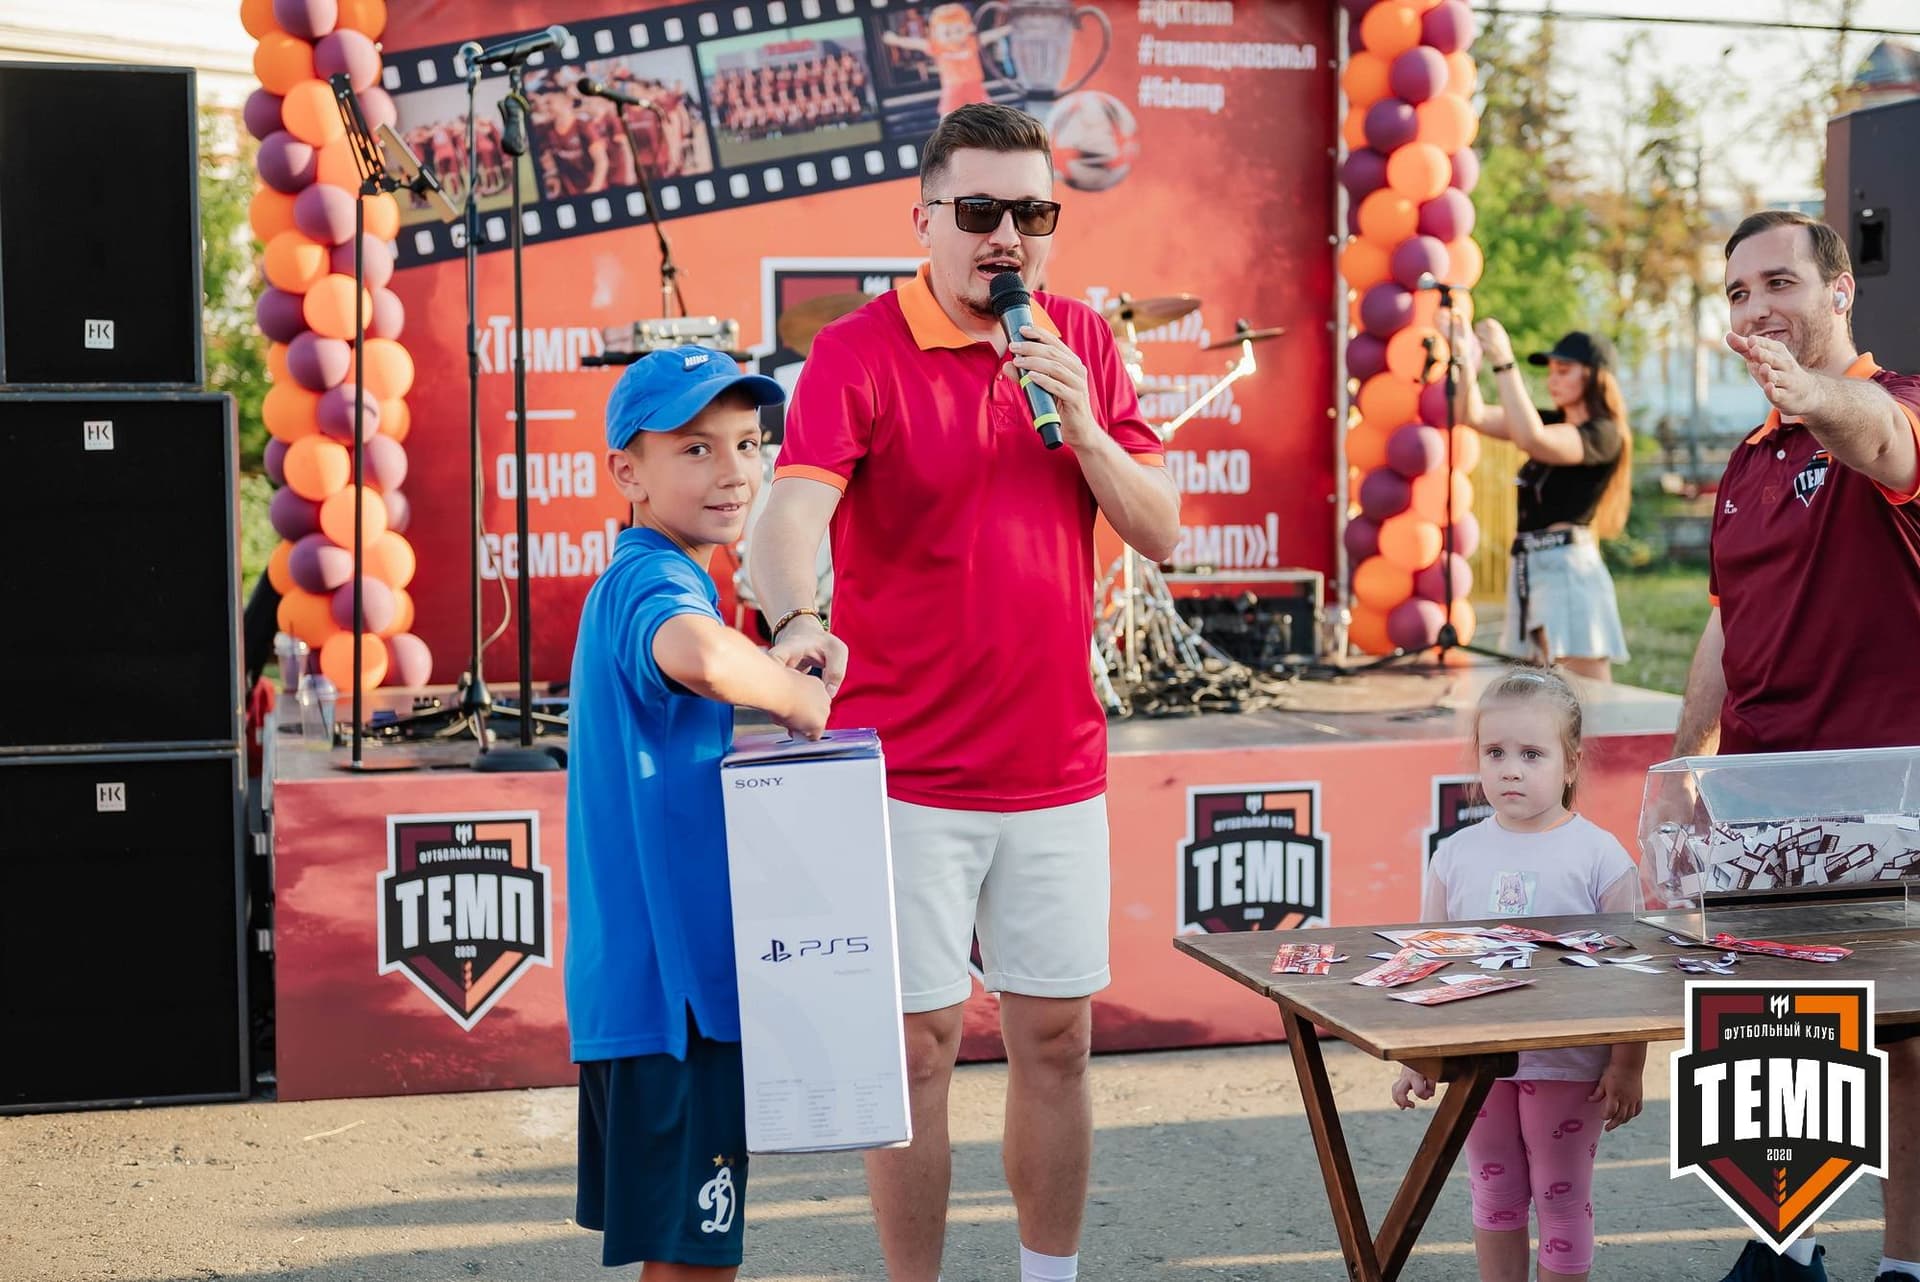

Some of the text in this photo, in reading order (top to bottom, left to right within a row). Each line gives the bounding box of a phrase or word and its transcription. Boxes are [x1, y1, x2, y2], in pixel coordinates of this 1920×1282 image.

[89, 324, 110, 339] HK
[88, 425, 109, 440] HK
[496, 452, 597, 505] одна
[1166, 449, 1250, 495] лько
[1798, 467, 1828, 491] ТЕМ
[479, 518, 618, 580] семья!
[100, 786, 121, 801] HK
[735, 777, 783, 789] SONY
[419, 845, 509, 864] ФУТБОЛЬНЫЙ КЛУБ
[1192, 840, 1316, 912] ТЕМП
[395, 873, 535, 949] ТЕМП
[800, 936, 869, 957] PS5
